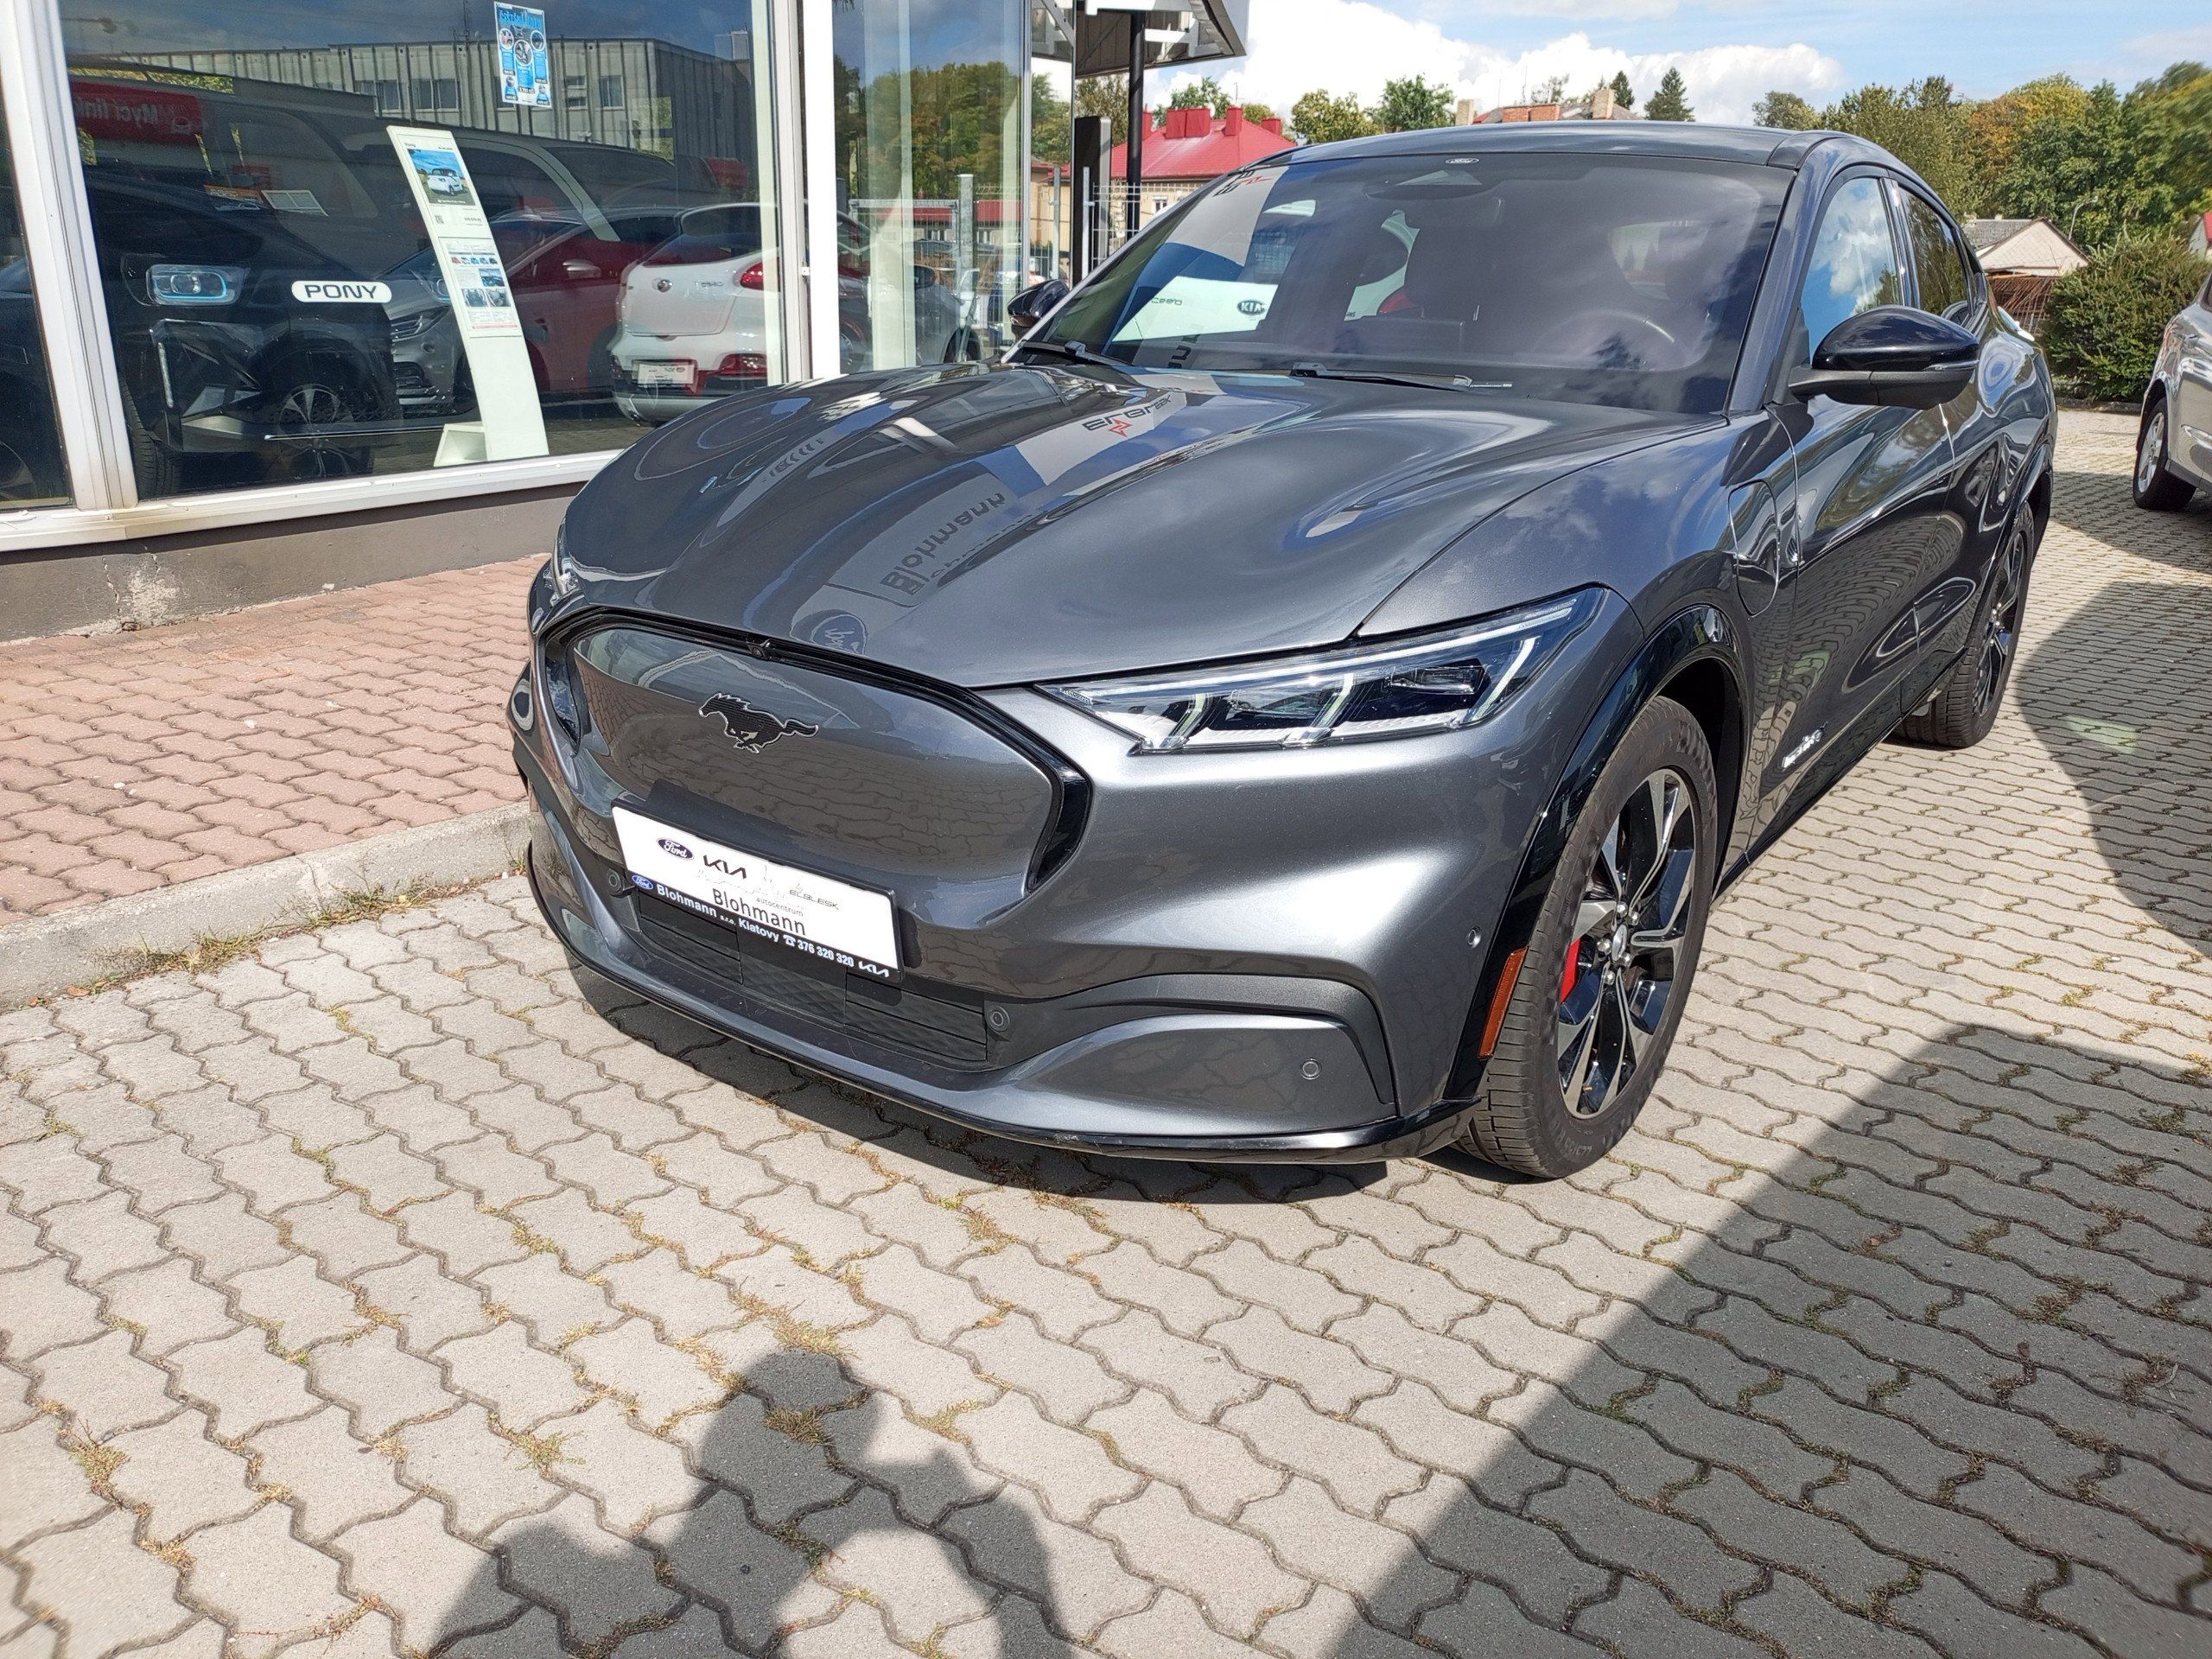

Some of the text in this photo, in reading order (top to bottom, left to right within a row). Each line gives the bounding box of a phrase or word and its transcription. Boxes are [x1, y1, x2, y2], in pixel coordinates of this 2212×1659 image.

[304, 284, 378, 299] PONY
[712, 887, 806, 936] Blohmann
[756, 897, 804, 918] autocentrum
[656, 884, 717, 918] Blohmann
[738, 918, 779, 943] Klatovy
[797, 939, 816, 954] 376
[817, 947, 836, 962] 320
[836, 953, 855, 968] 320
